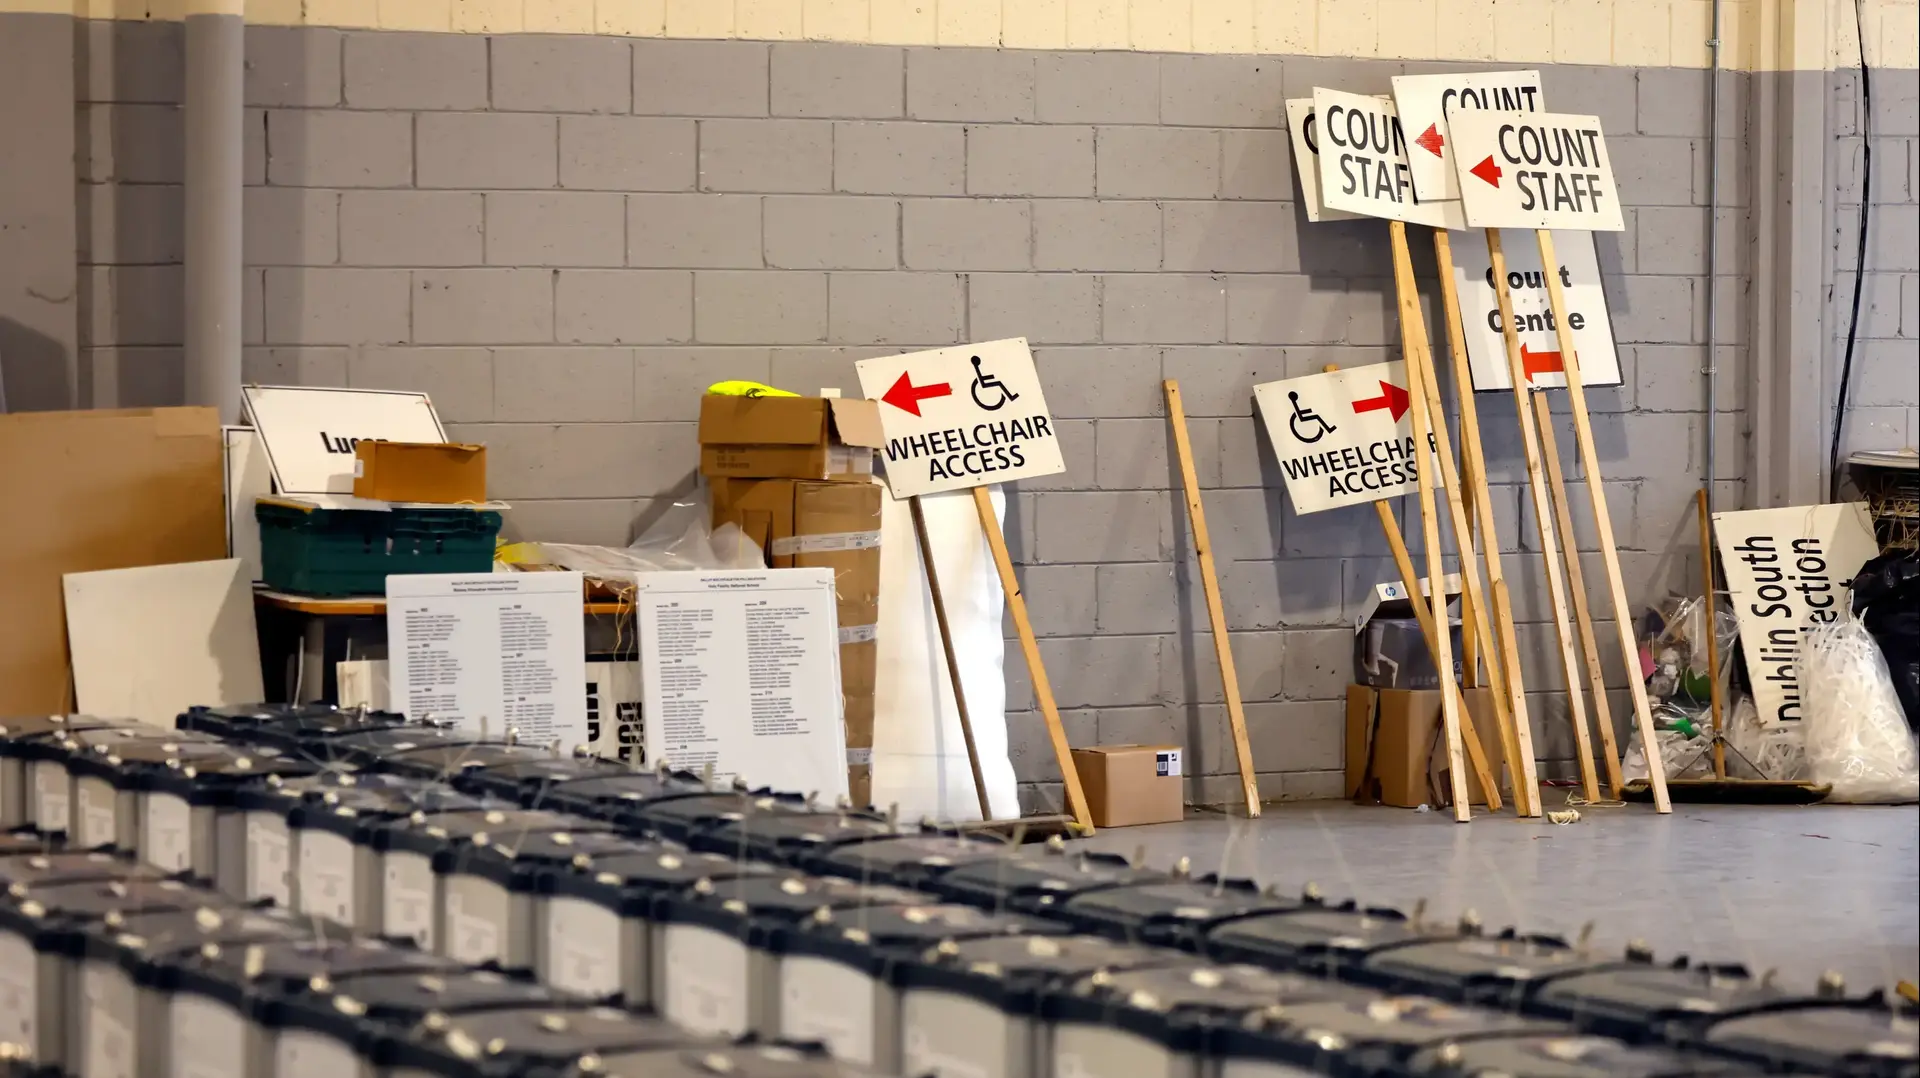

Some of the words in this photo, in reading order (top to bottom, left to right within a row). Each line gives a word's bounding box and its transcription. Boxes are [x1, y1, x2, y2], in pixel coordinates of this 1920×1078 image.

[1327, 104, 1408, 157] COUN
[1498, 123, 1601, 168] COUNT
[1340, 153, 1418, 205] STAF
[1516, 170, 1603, 213] STAFF
[1485, 265, 1572, 290] out
[1487, 308, 1585, 333] Cente
[320, 431, 389, 454] Luc
[886, 415, 1052, 462] WHEELCHAIR
[1282, 432, 1438, 480] WHEELCHA
[929, 444, 1025, 481] ACCESS
[1329, 460, 1418, 498] ACCESS
[1733, 536, 1793, 618] South
[1787, 538, 1838, 633] lection
